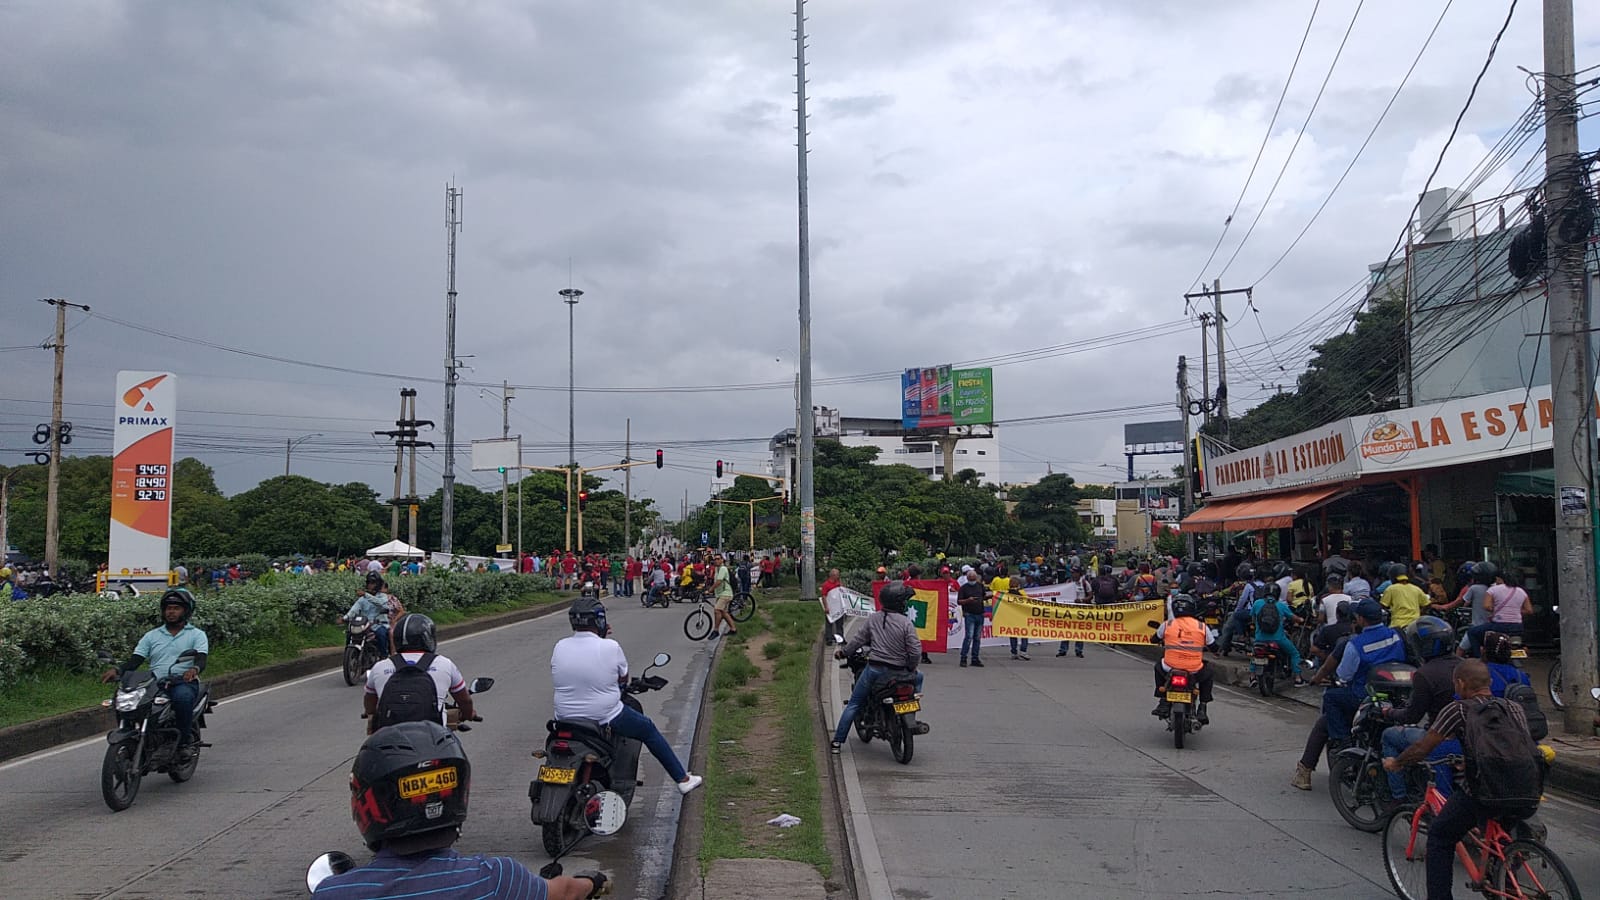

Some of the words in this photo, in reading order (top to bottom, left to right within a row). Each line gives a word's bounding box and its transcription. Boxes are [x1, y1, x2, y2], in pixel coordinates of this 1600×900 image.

[119, 417, 168, 425] PRIMAX
[1411, 417, 1451, 449] LA
[1461, 399, 1553, 441] ESTA
[1363, 443, 1395, 456] Mundo
[1396, 441, 1414, 450] Pan
[1215, 456, 1260, 486] PANADERIA
[1276, 449, 1288, 475] LA
[1293, 430, 1346, 472] ESTACIÓN
[1007, 596, 1024, 604] LAS
[1110, 603, 1158, 611] USUARIOS
[1031, 607, 1051, 618] DE
[1055, 609, 1072, 620] LA
[1077, 611, 1124, 621] SALUD
[1027, 618, 1093, 630] PRESENTES
[1095, 622, 1111, 632] EN
[1113, 623, 1128, 632] EL
[1000, 626, 1028, 636] PARO
[1031, 628, 1096, 640] CIUDADANO
[1099, 632, 1152, 643] DISTRITA
